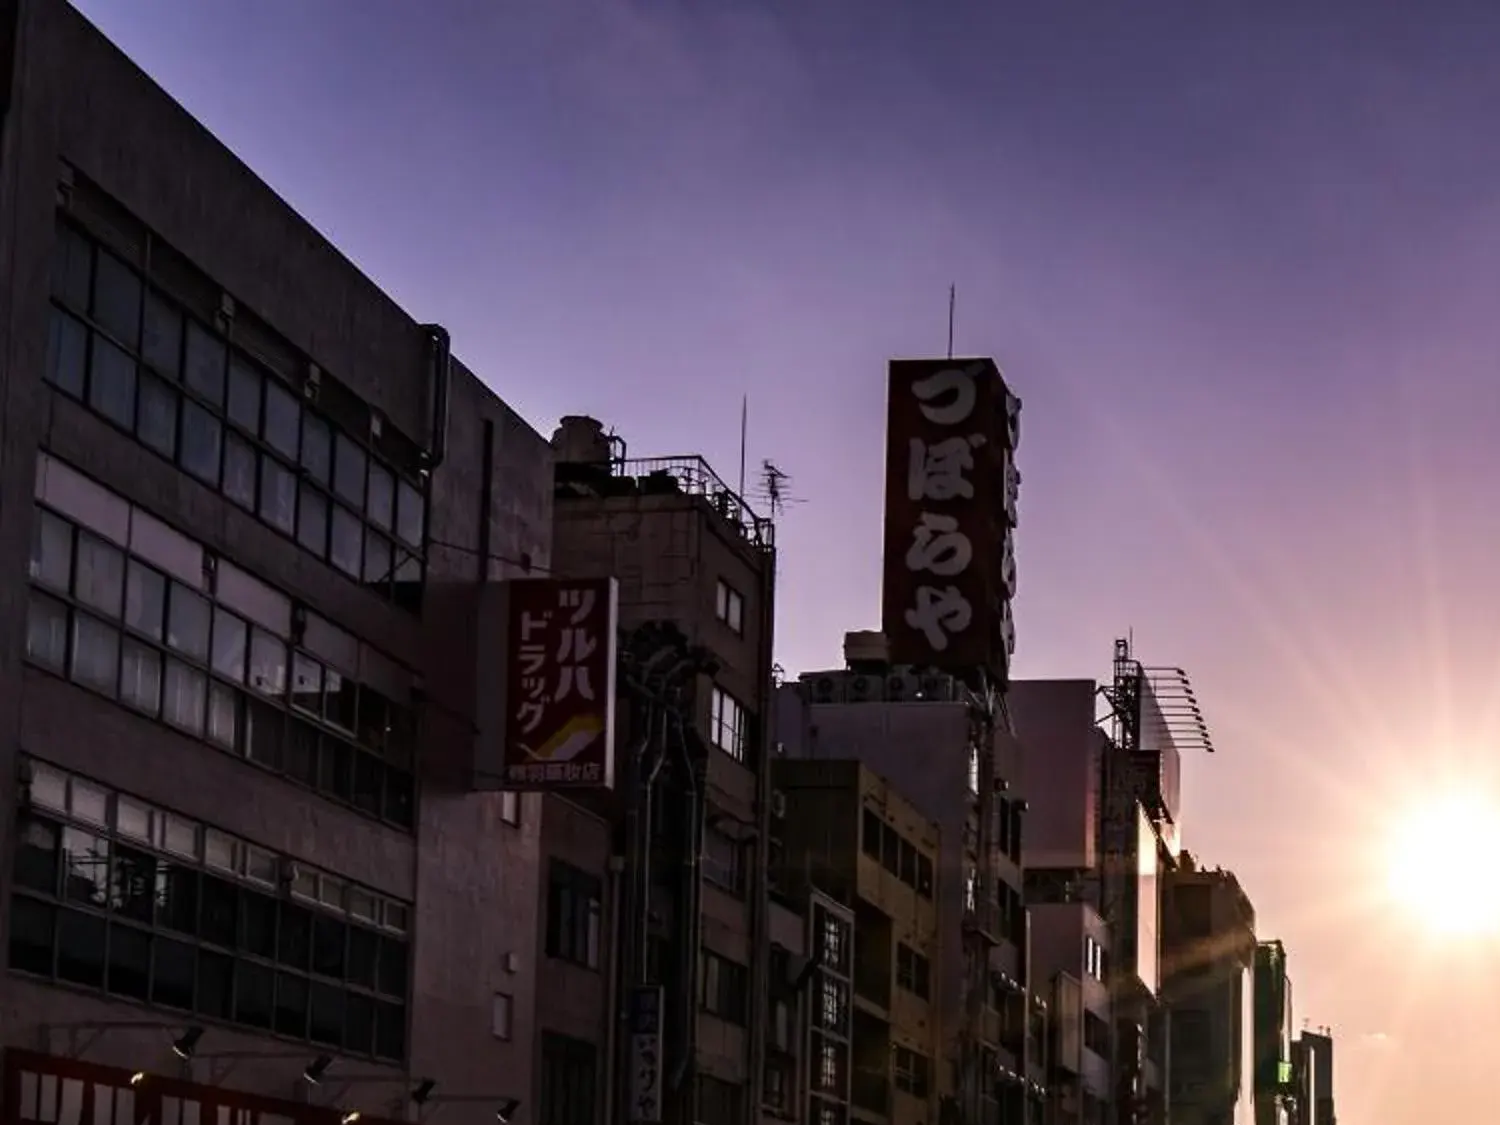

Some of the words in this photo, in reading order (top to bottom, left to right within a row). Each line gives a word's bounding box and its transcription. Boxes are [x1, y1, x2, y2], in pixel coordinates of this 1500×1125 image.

[905, 360, 987, 651] づぼらや
[515, 610, 554, 734] ドラッグ
[553, 588, 598, 704] ツルハ
